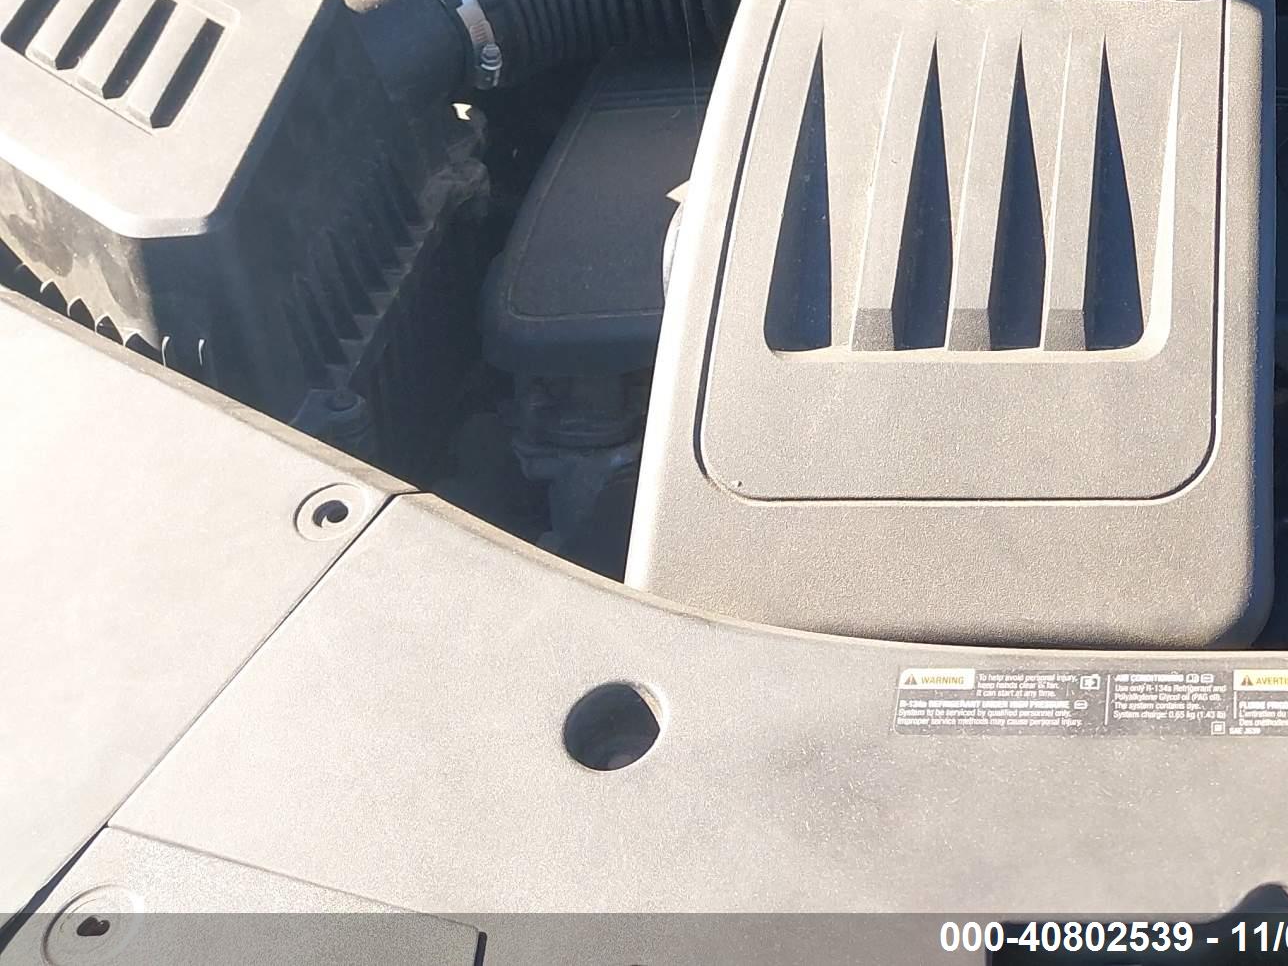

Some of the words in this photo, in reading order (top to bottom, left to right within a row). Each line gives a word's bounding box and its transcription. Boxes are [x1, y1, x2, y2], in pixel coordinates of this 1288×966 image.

[922, 676, 964, 684] WARNING
[978, 674, 987, 682] To
[1005, 674, 1024, 682] avoid
[1024, 674, 1055, 682] personal
[983, 690, 996, 698] can
[998, 690, 1014, 698] start
[1024, 690, 1036, 698] any
